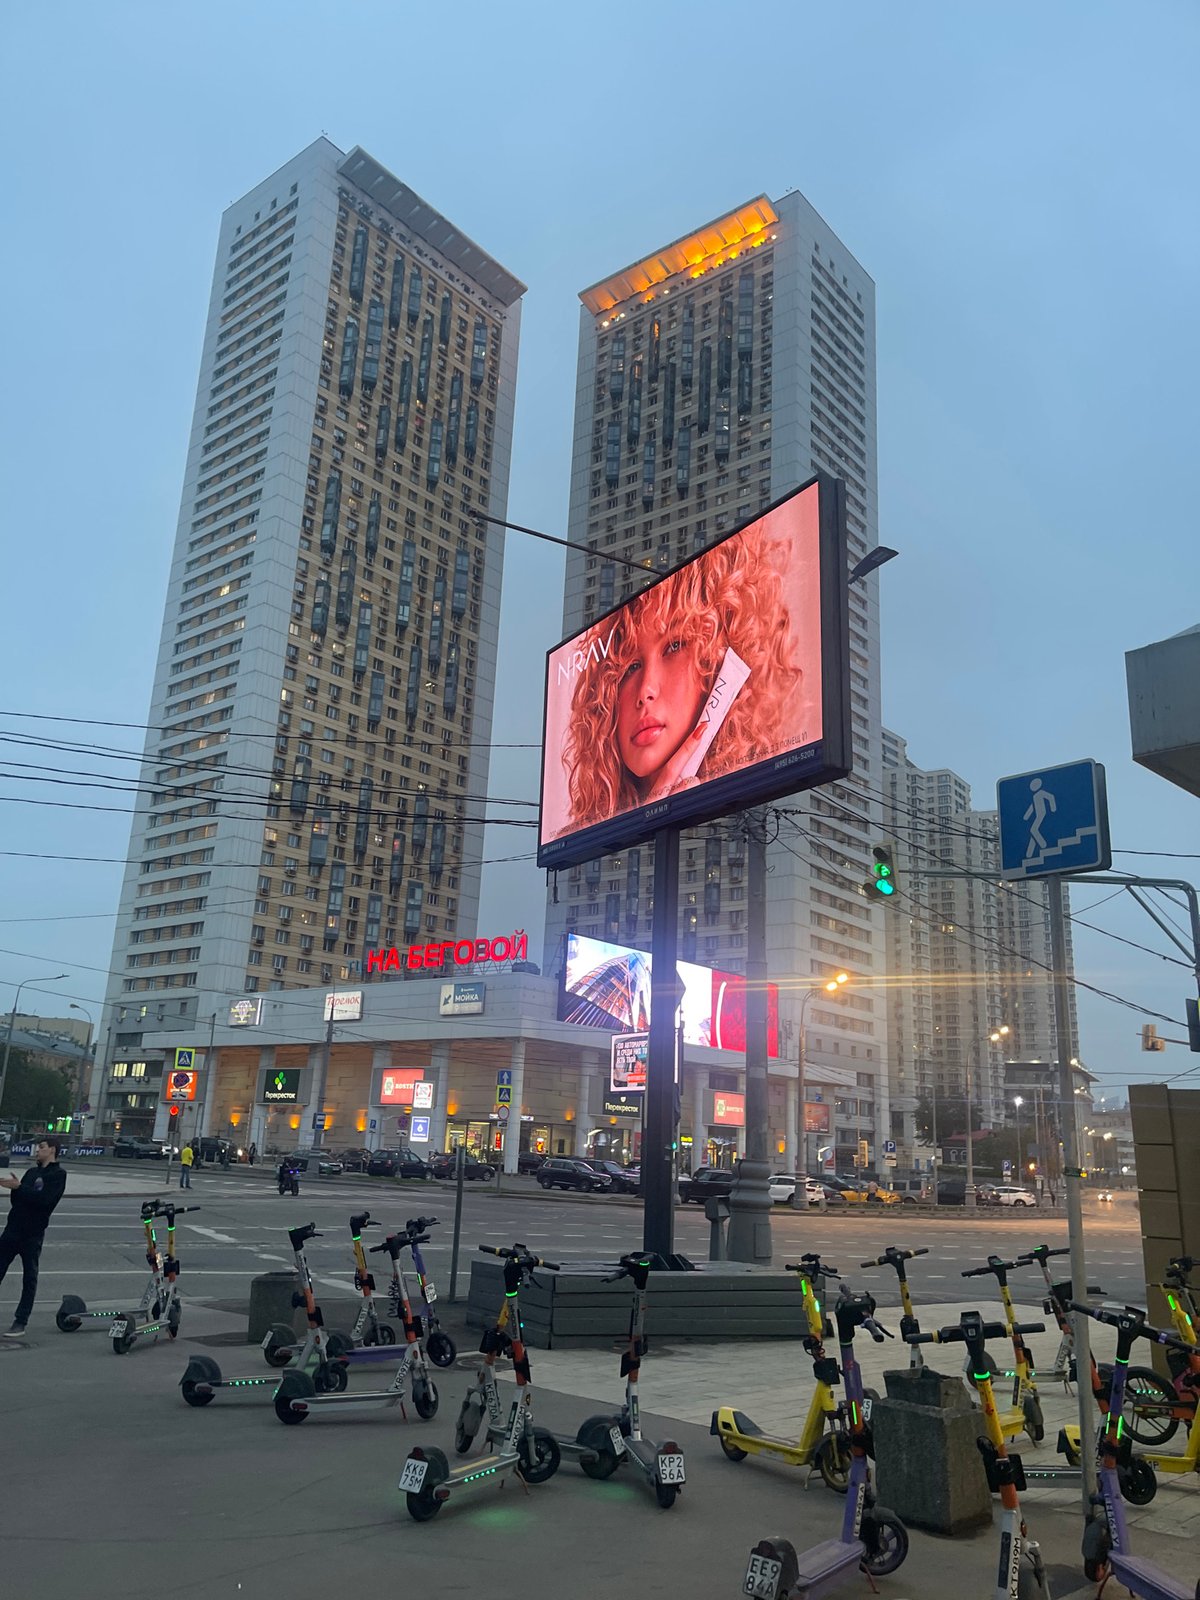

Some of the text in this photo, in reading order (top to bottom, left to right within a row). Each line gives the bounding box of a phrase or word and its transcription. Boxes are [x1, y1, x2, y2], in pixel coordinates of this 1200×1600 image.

[557, 629, 614, 686] NRAV
[367, 947, 400, 972] НА
[407, 928, 528, 969] БЕГОВОЙ
[455, 992, 479, 1002] МОЙКА
[265, 1091, 296, 1100] Перекресток
[605, 1102, 639, 1113] Перекресток
[393, 1358, 412, 1390] KB097E
[485, 1383, 498, 1422] KE670A
[512, 1405, 526, 1448] KK875M
[405, 1462, 425, 1476] KK8
[660, 1456, 683, 1468] KP2
[402, 1474, 422, 1488] 75M
[661, 1469, 684, 1481] 56A
[750, 1558, 779, 1580] EE9
[1010, 1537, 1021, 1598] KT989M
[746, 1575, 774, 1598] 84A
